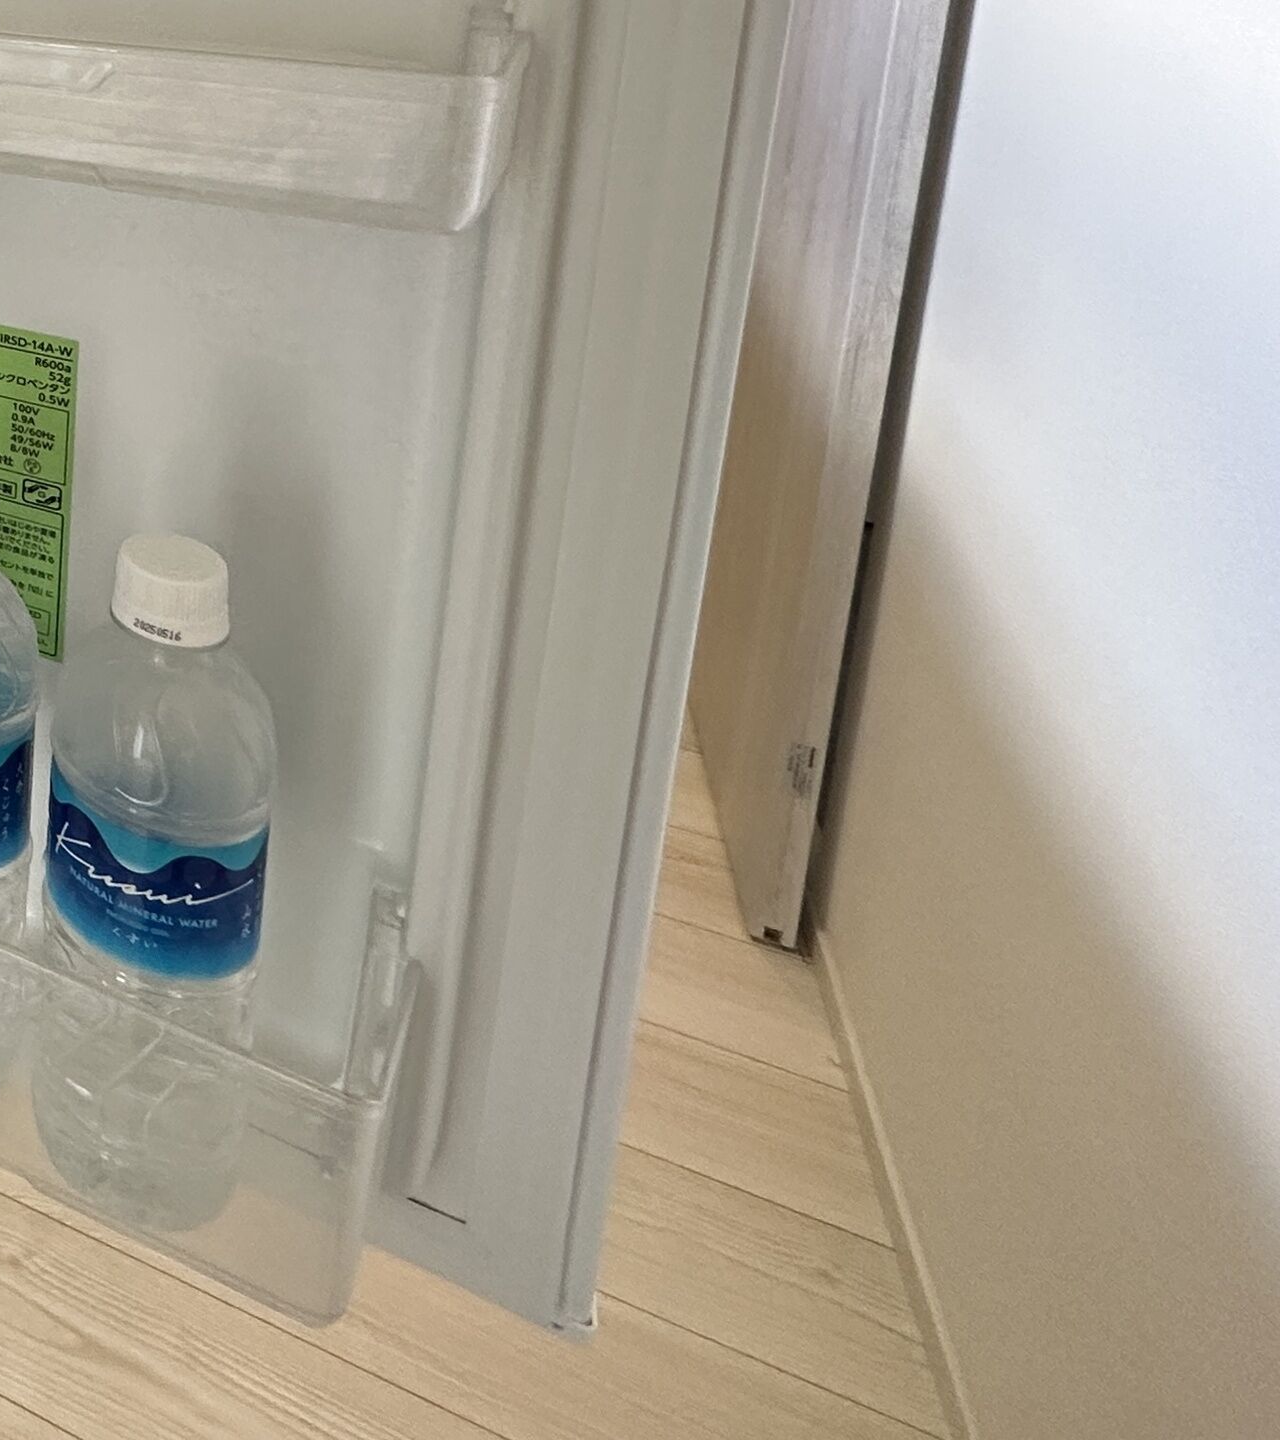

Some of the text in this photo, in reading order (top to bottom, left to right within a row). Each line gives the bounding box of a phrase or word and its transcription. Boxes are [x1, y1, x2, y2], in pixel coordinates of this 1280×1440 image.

[0, 333, 74, 358] IRSD-14A-W
[35, 357, 72, 374] R600a
[49, 371, 72, 388] 52g
[38, 392, 71, 409] 0.5W
[132, 617, 182, 642] 20250516
[69, 864, 114, 905] NATURAL
[117, 900, 175, 927] MINERAL
[177, 917, 219, 929] WATER
